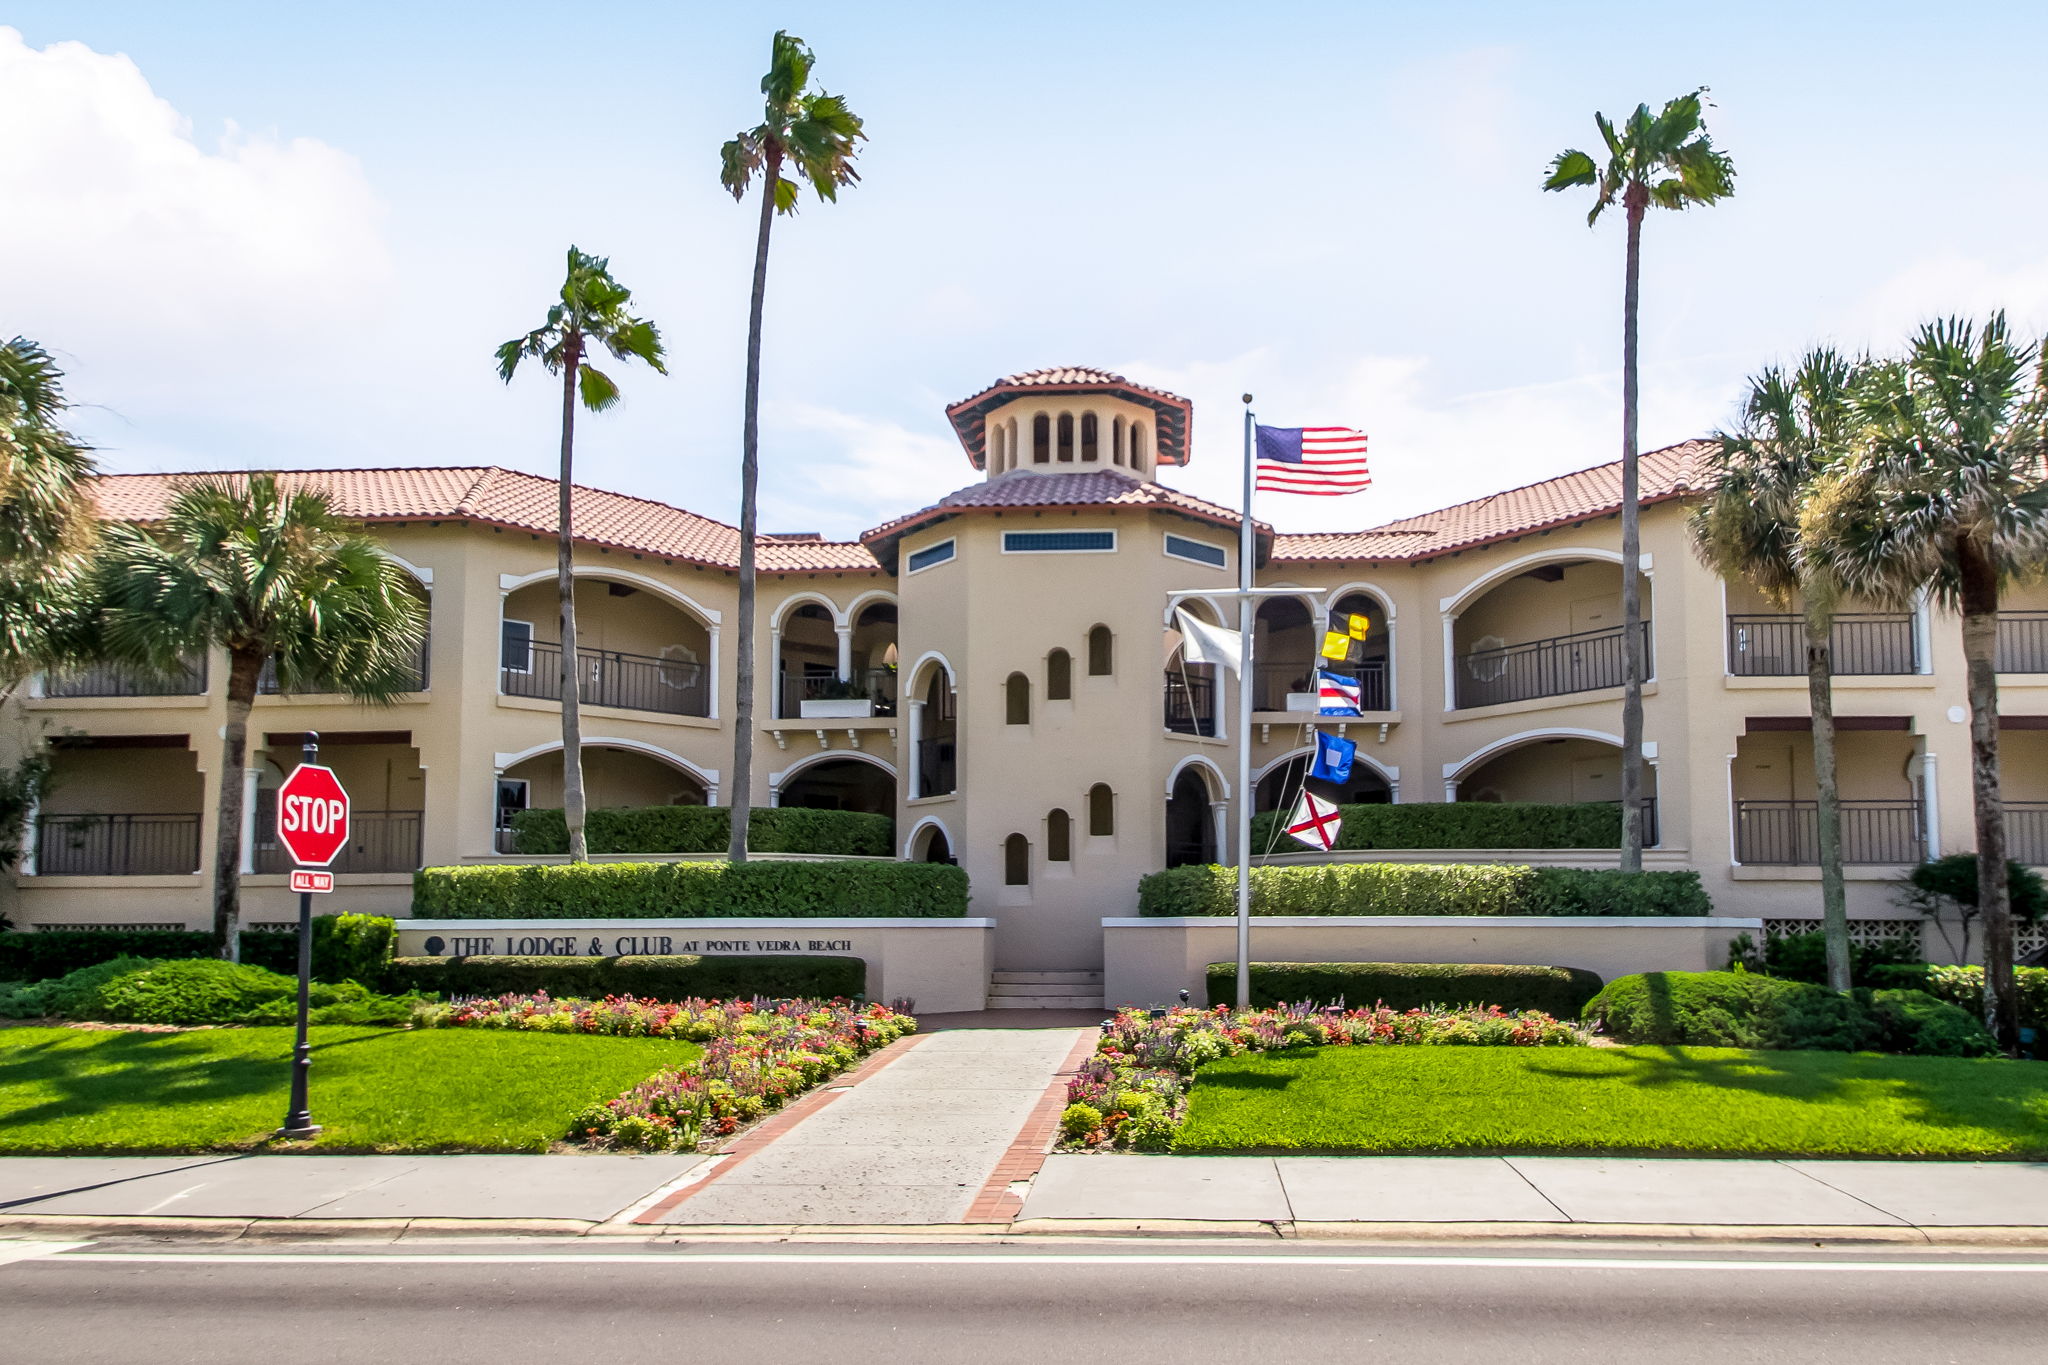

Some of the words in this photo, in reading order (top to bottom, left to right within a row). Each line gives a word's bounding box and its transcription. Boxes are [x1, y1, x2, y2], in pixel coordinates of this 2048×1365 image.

[284, 794, 344, 834] STOP
[295, 875, 311, 887] ALL
[313, 876, 330, 888] WAY
[450, 937, 494, 956] THE
[506, 937, 577, 956] LODGE
[588, 937, 603, 956] &
[615, 936, 673, 956] CLUB
[682, 940, 700, 951] AT
[706, 940, 750, 951] PONTE
[756, 940, 801, 951] VEDRA
[808, 940, 851, 951] BEACH
